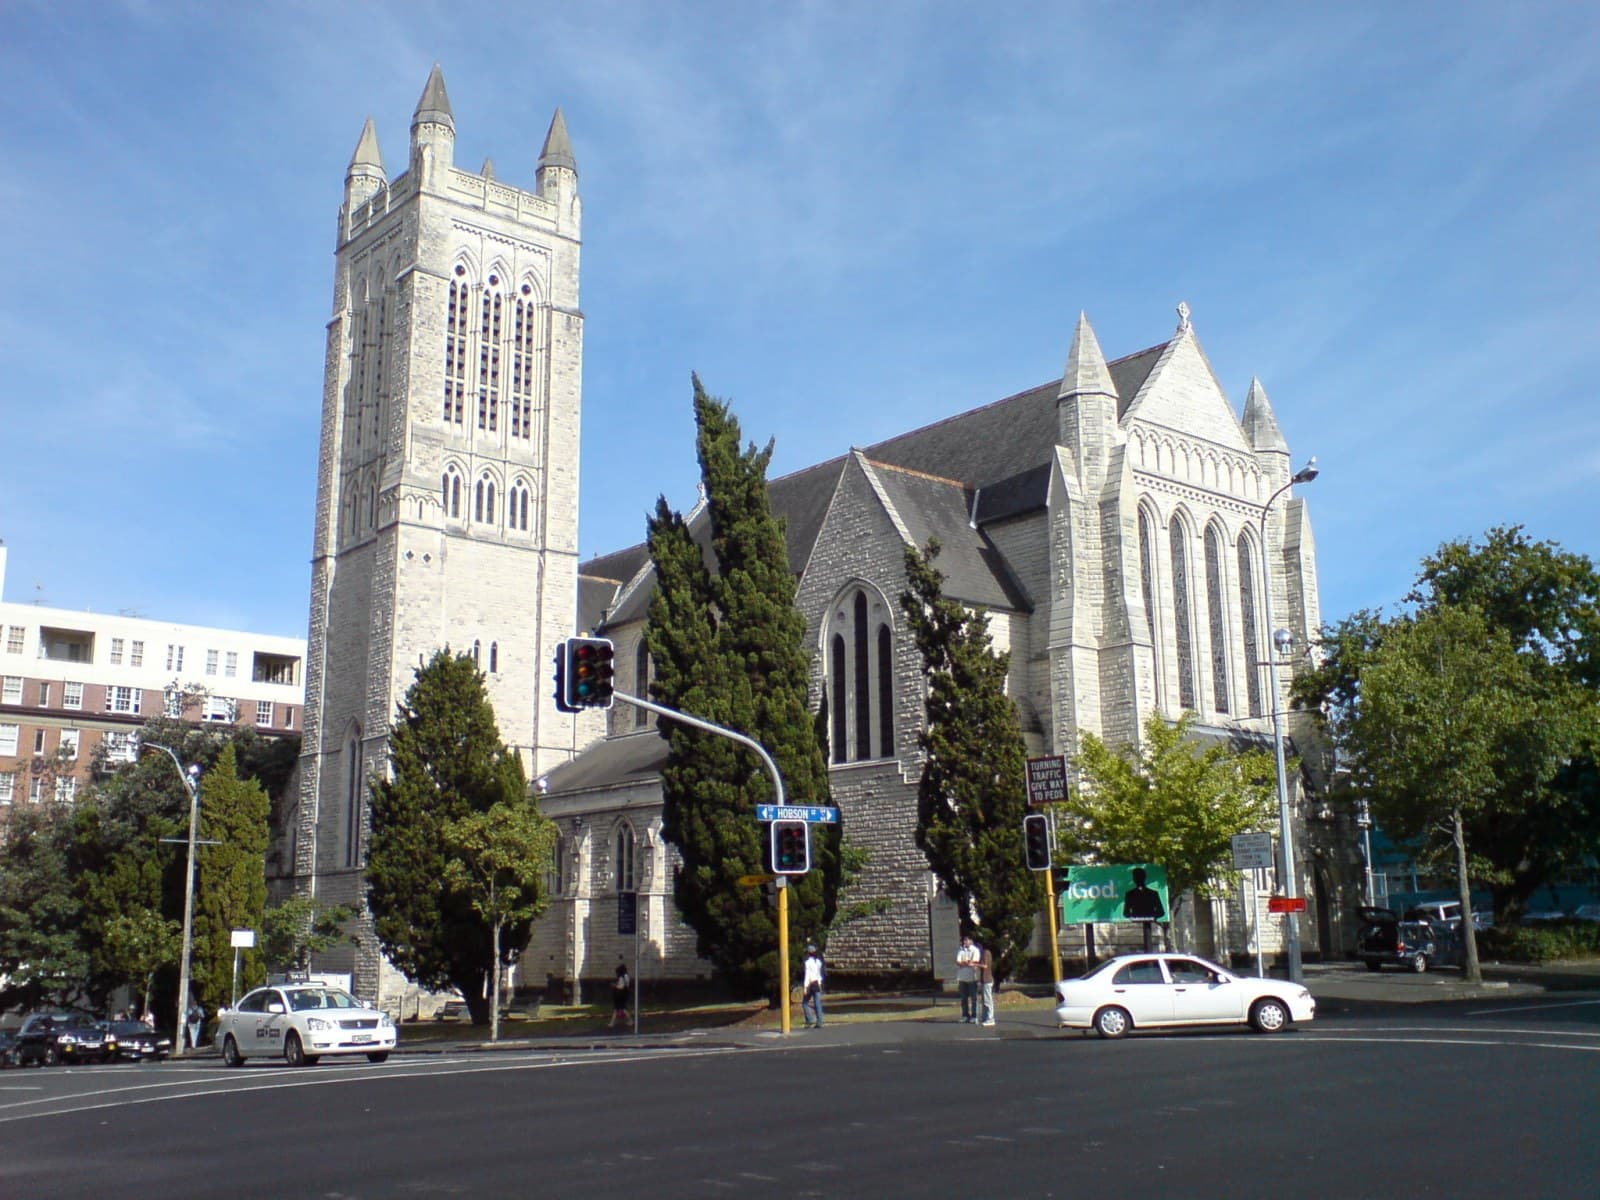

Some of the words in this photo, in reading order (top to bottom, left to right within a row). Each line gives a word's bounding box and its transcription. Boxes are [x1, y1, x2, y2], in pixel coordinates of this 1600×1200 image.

[1031, 760, 1061, 770] TURNING
[1032, 770, 1061, 780] TRAFFIC
[1031, 781, 1047, 791] GIVE
[1049, 779, 1064, 789] WAY
[1034, 791, 1043, 801] TO
[1045, 790, 1064, 800] PEDS
[777, 807, 808, 820] HOBSON
